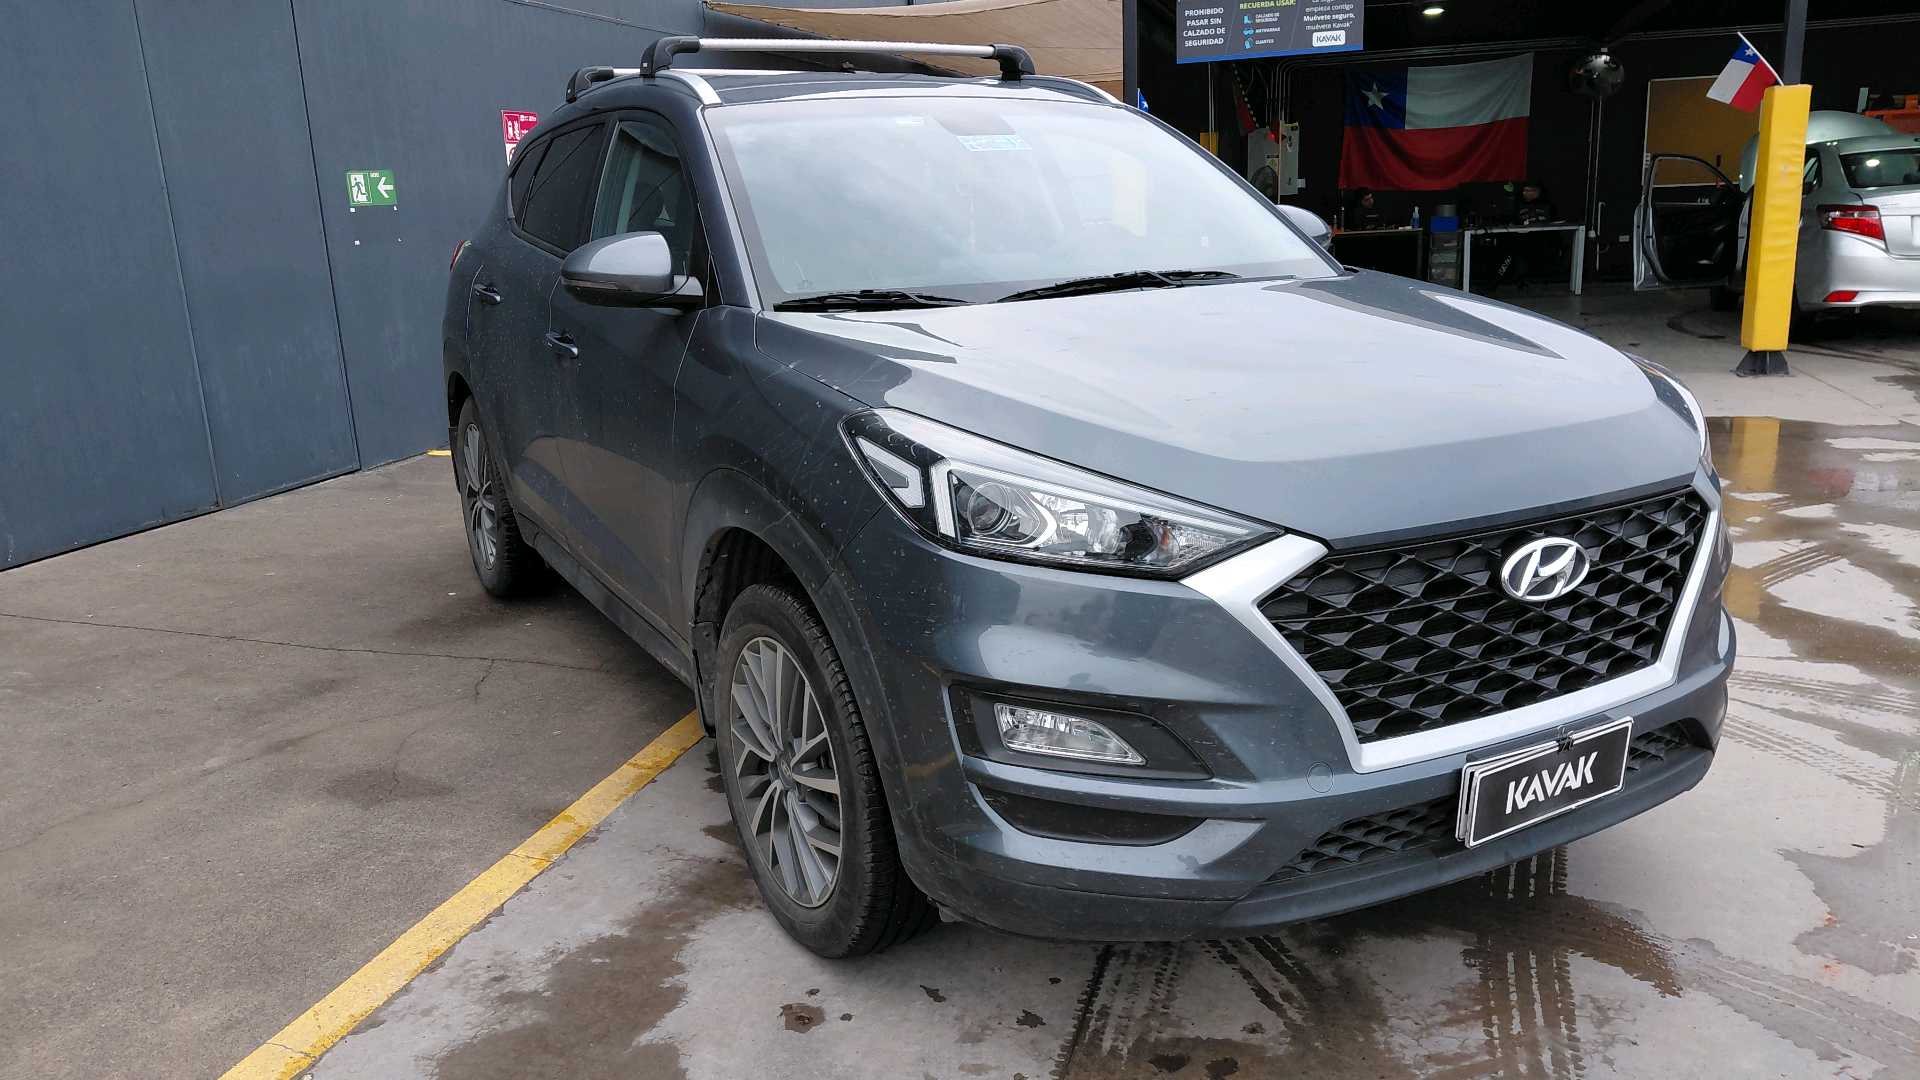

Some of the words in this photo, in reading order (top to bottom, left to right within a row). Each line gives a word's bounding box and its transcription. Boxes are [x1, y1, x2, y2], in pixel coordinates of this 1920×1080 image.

[1239, 1, 1275, 9] RECUERDA
[1331, 3, 1354, 11] contigo
[1184, 8, 1224, 16] PROHIBIDO
[1210, 17, 1222, 25] SIN
[1183, 28, 1215, 37] CALZADO
[1216, 27, 1226, 35] DE
[1184, 38, 1224, 47] SEGURIDAD
[1316, 34, 1343, 43] KAVAK
[1505, 751, 1599, 815] KAVAK
